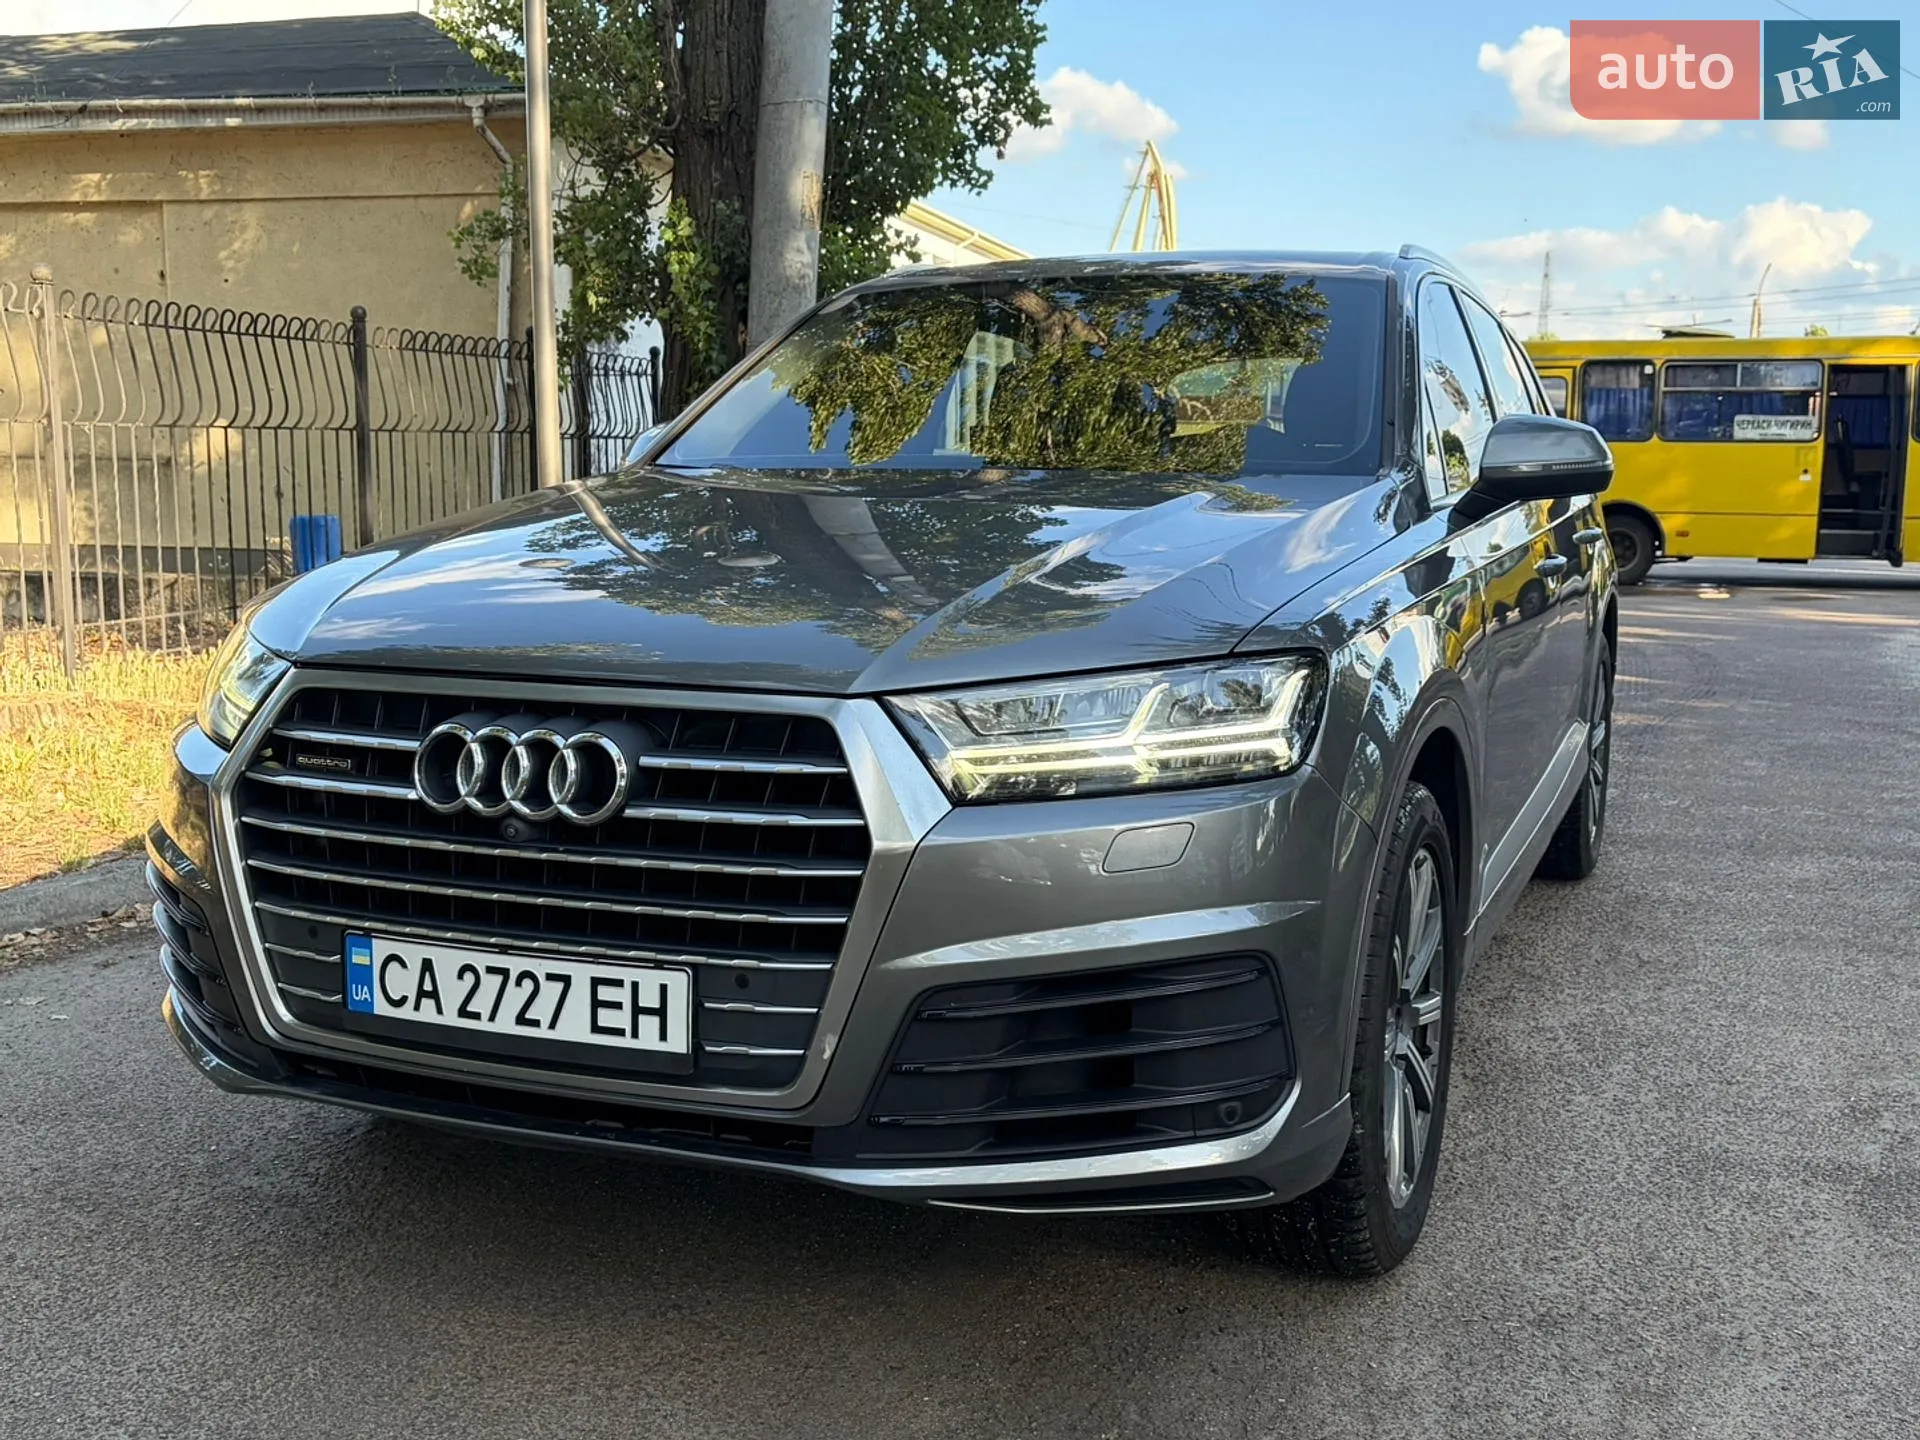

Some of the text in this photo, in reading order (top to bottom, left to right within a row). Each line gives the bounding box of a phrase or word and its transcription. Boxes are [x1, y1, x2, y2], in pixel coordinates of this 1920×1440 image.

[297, 757, 348, 768] quattro
[352, 983, 372, 1003] UA
[378, 953, 669, 1043] CA 2727 EH
